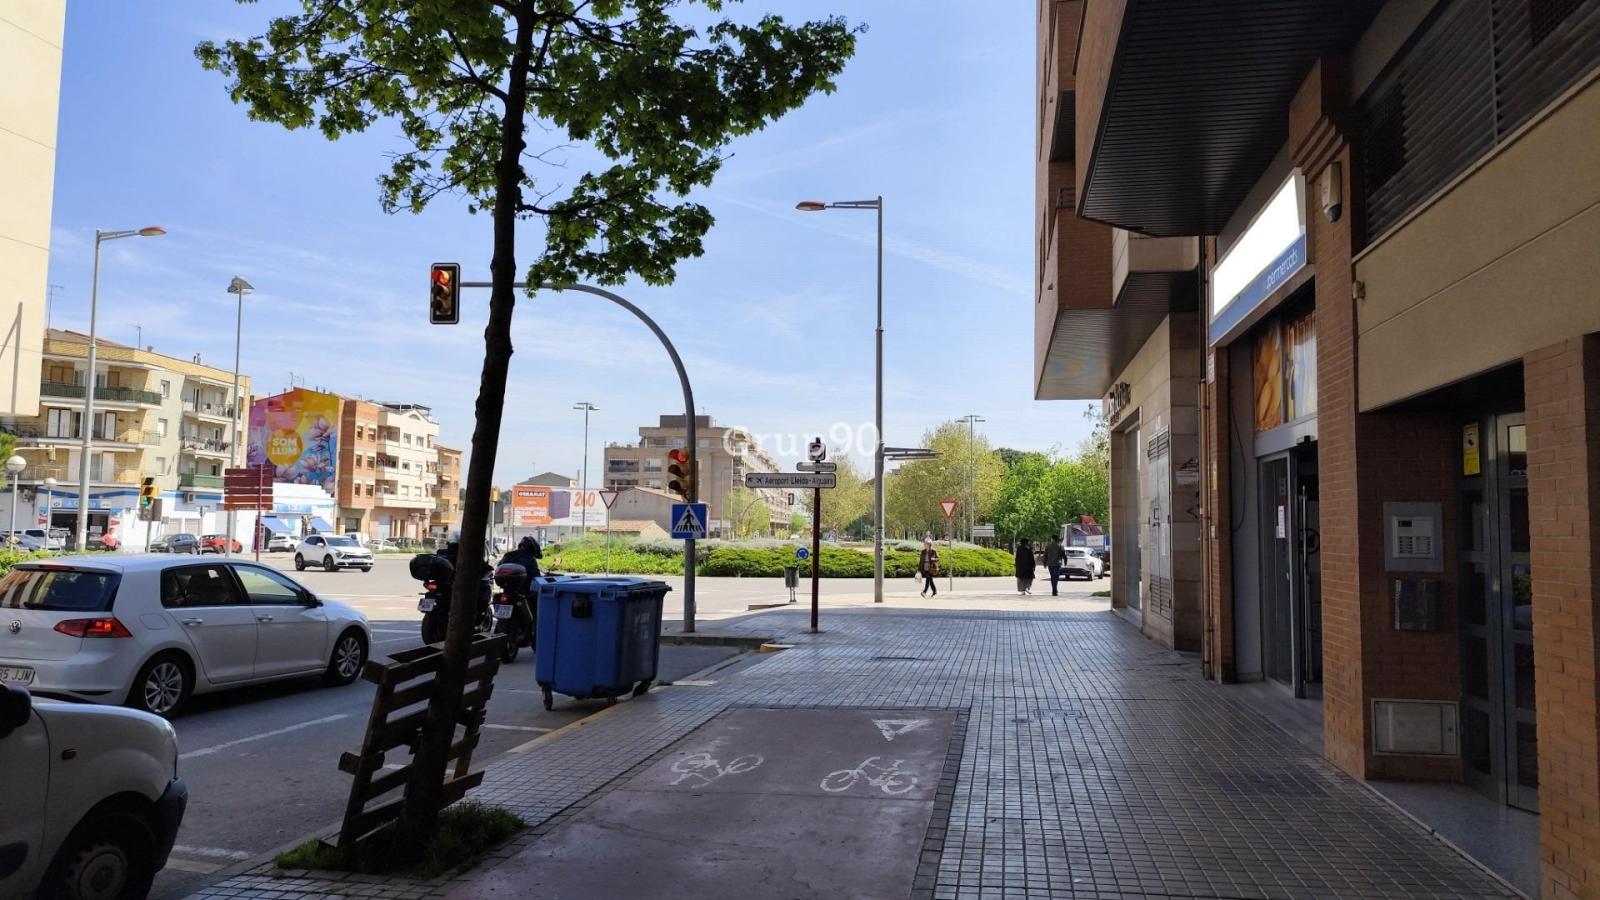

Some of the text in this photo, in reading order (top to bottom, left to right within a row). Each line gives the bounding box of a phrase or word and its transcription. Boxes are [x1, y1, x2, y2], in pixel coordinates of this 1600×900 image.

[1265, 248, 1298, 290] permercats
[272, 437, 297, 447] SOM
[272, 447, 297, 456] LLUM
[764, 476, 789, 486] Aeroport
